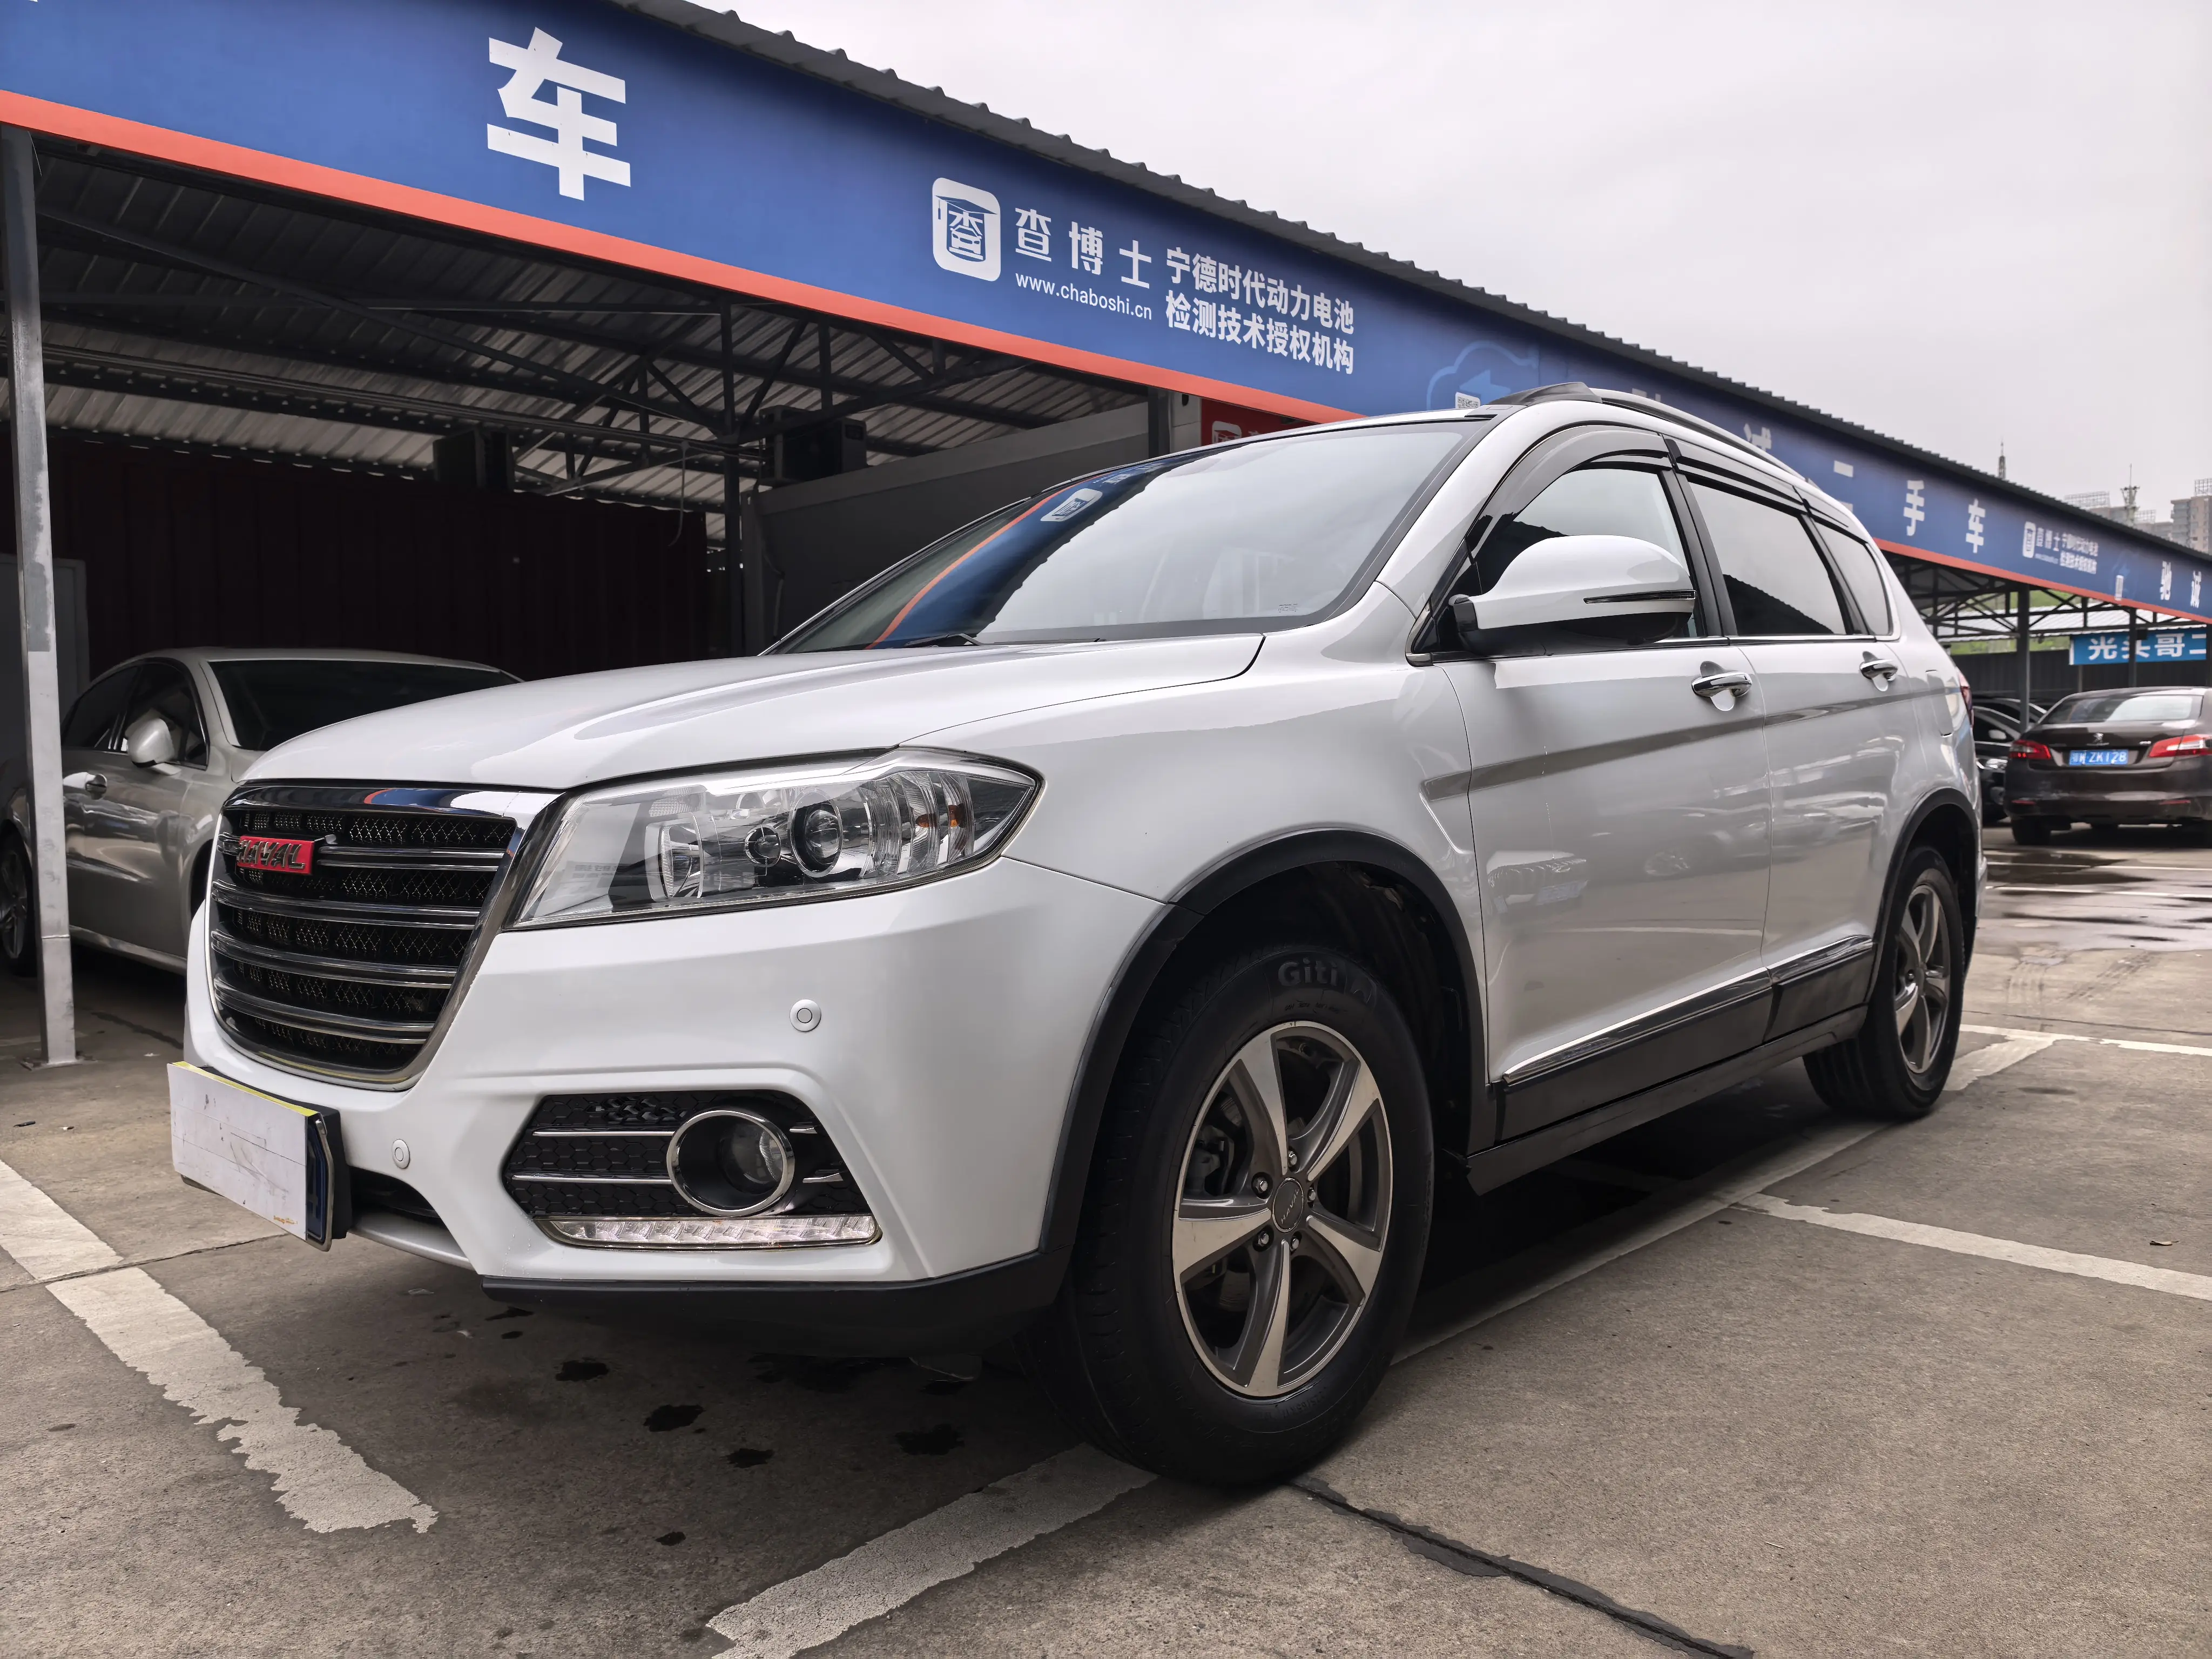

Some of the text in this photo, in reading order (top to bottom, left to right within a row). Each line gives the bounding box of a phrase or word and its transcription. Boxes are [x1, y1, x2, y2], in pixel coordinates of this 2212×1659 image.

[487, 27, 631, 201] 车
[1015, 207, 1152, 288] 查博士
[1015, 273, 1152, 320] www.chaboshi.cn
[1165, 289, 1354, 374] 检测技术授权机构
[1166, 247, 1354, 335] 宁德时代动力电池
[1278, 957, 1338, 986] Giti
[1281, 1189, 1299, 1224] HAVAL
